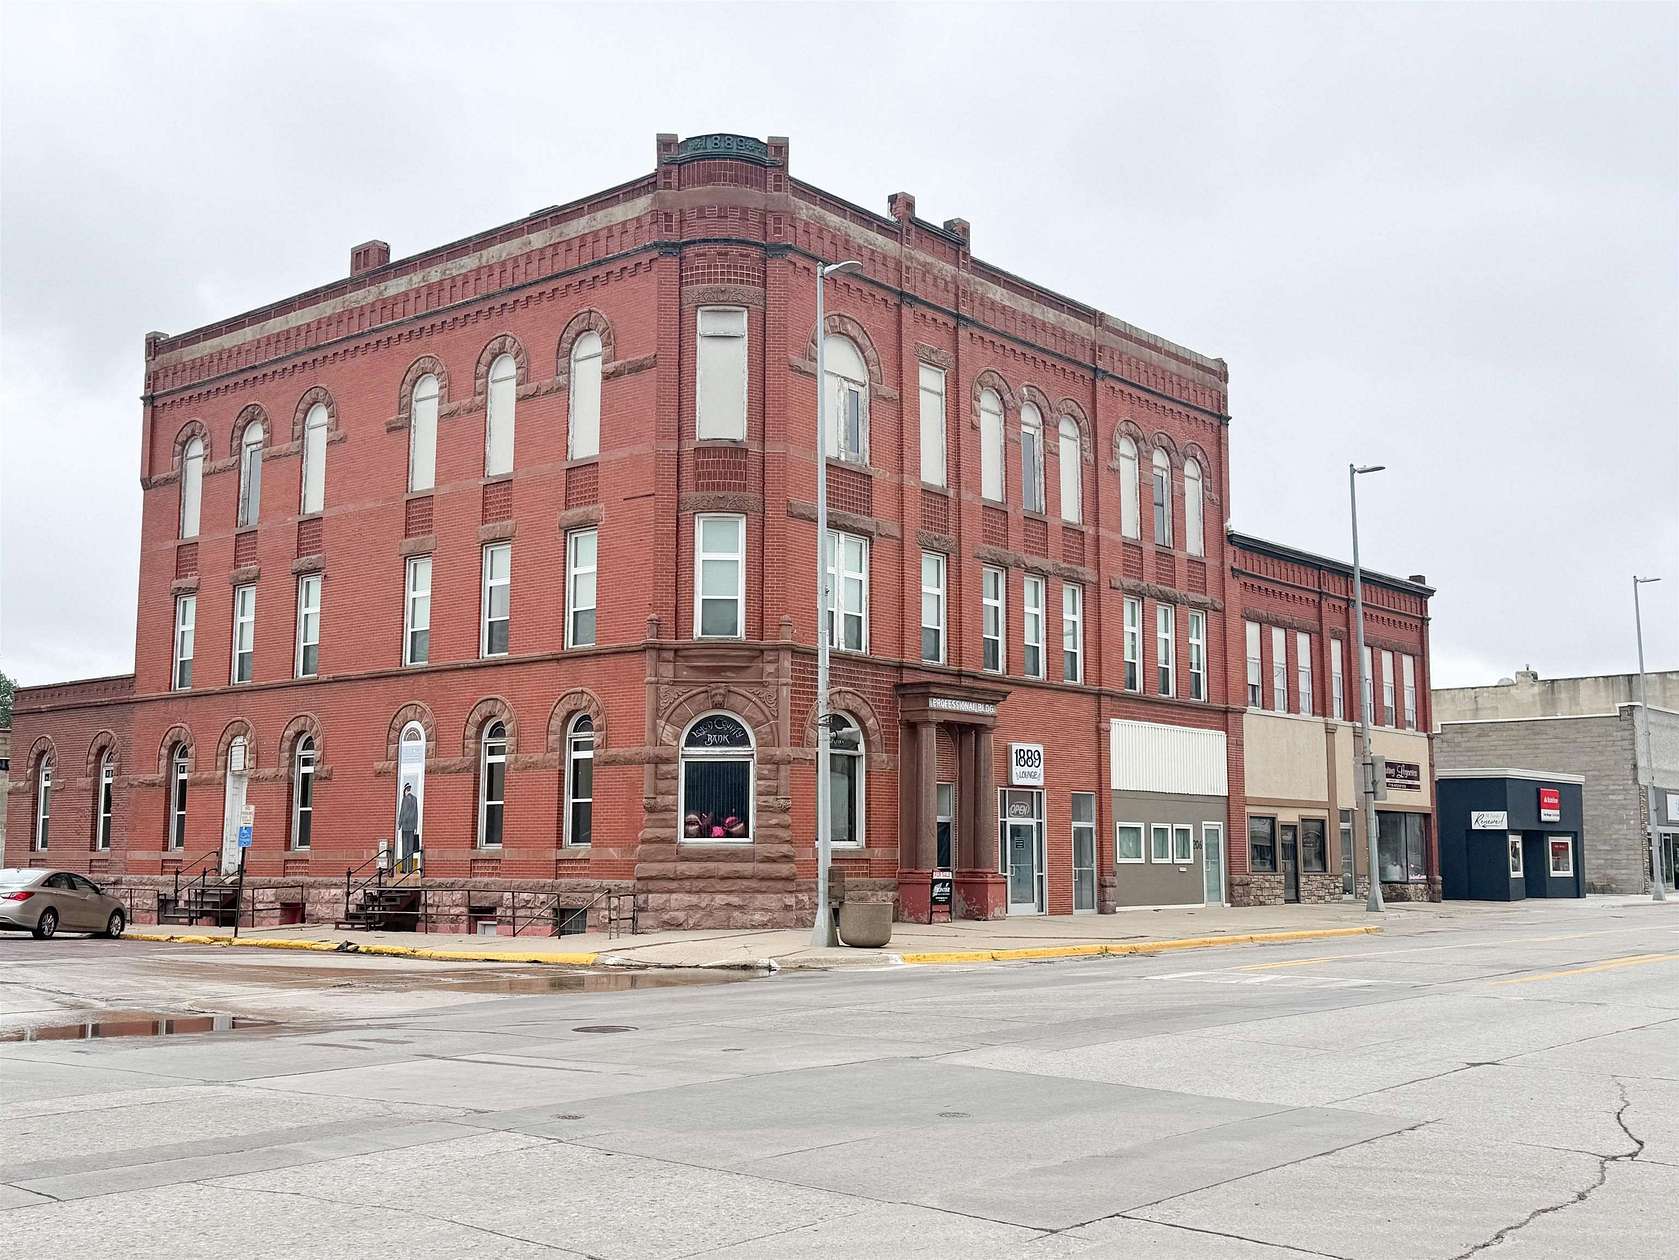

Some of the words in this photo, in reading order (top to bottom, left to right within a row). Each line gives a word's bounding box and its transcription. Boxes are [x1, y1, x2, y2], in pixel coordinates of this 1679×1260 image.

[702, 135, 745, 150] 1889
[1014, 748, 1041, 768] 1889
[1018, 770, 1038, 780] LOUNGE
[1010, 803, 1030, 816] OPEN
